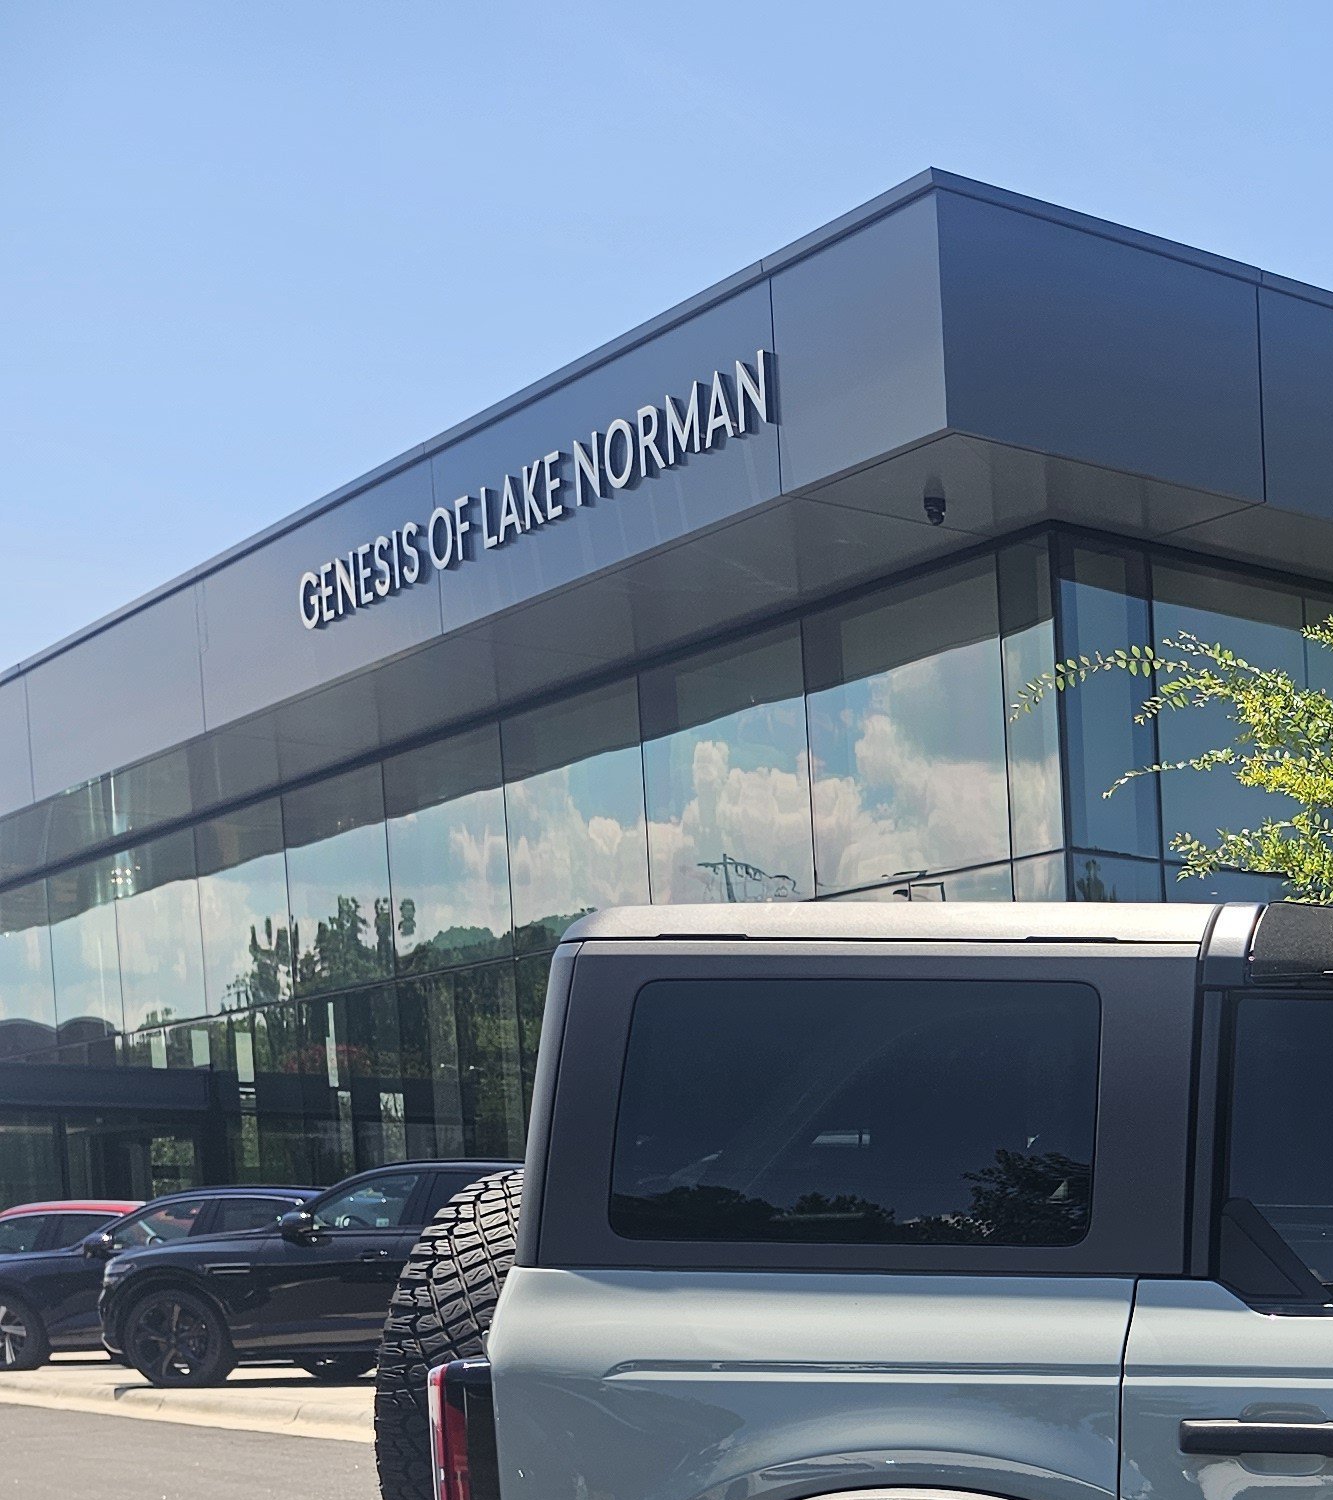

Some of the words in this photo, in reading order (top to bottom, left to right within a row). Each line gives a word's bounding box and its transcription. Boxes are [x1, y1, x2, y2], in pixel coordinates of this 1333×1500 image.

[299, 521, 420, 630] GENESIS
[427, 495, 470, 570] OF
[479, 450, 564, 550] LAKE
[573, 349, 769, 507] NORMAN
